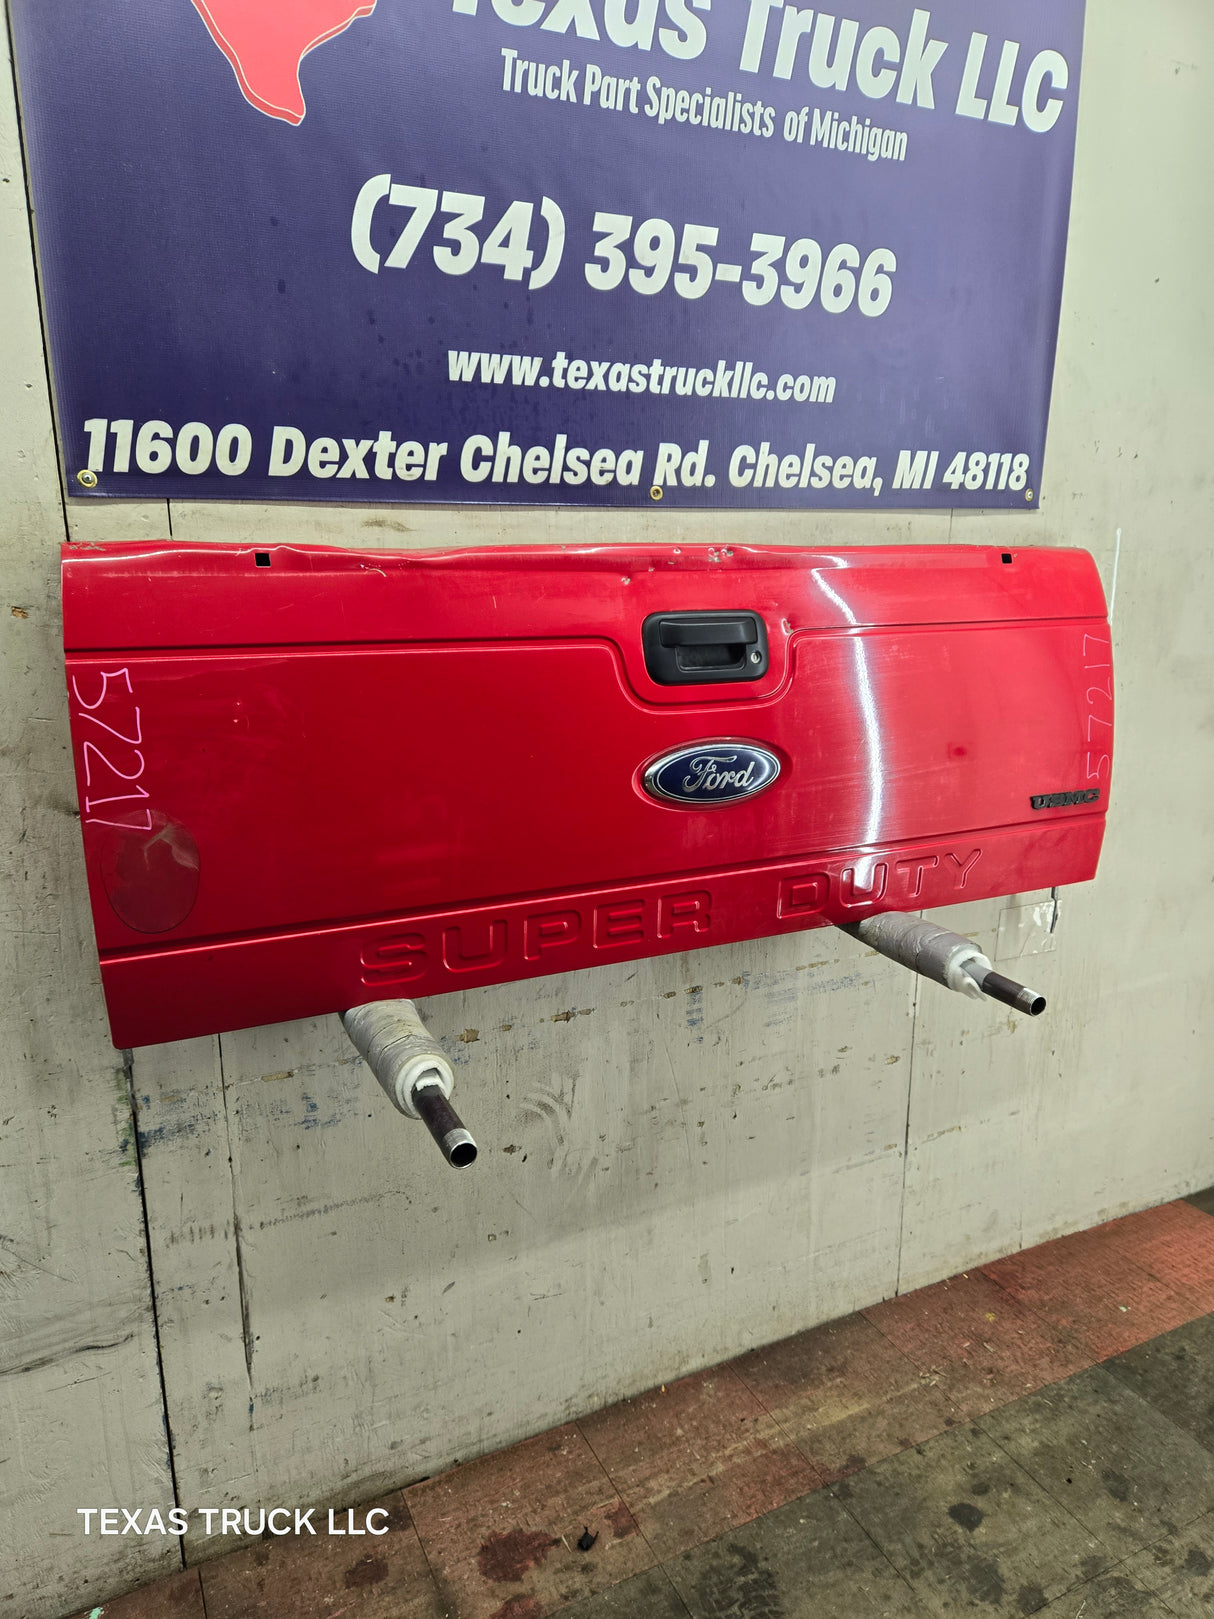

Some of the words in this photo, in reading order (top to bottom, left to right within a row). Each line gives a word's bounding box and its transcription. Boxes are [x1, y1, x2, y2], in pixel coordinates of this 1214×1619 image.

[452, 0, 711, 60] xas
[739, 0, 949, 109] Truck
[955, 32, 1070, 133] LLC
[501, 48, 578, 103] Truck
[583, 63, 641, 112] Part
[645, 76, 776, 139] Specialists
[783, 108, 808, 144] of
[810, 112, 909, 162] Michigan
[351, 173, 566, 290] (734)
[584, 212, 898, 318] 395-3966
[448, 350, 837, 404] www.texastruckllc.com
[83, 418, 253, 476] 11600
[268, 426, 448, 482] Dexter
[459, 432, 643, 487] Chelsea
[653, 441, 716, 488] Rd.
[728, 442, 884, 497] Chelsea,
[892, 451, 939, 490] MI
[943, 452, 1030, 491] 48118
[72, 667, 153, 832] 57217
[1082, 632, 1113, 780] 57217
[682, 756, 754, 792] Ford
[359, 890, 713, 987] SUPER
[775, 848, 984, 921] DUTY
